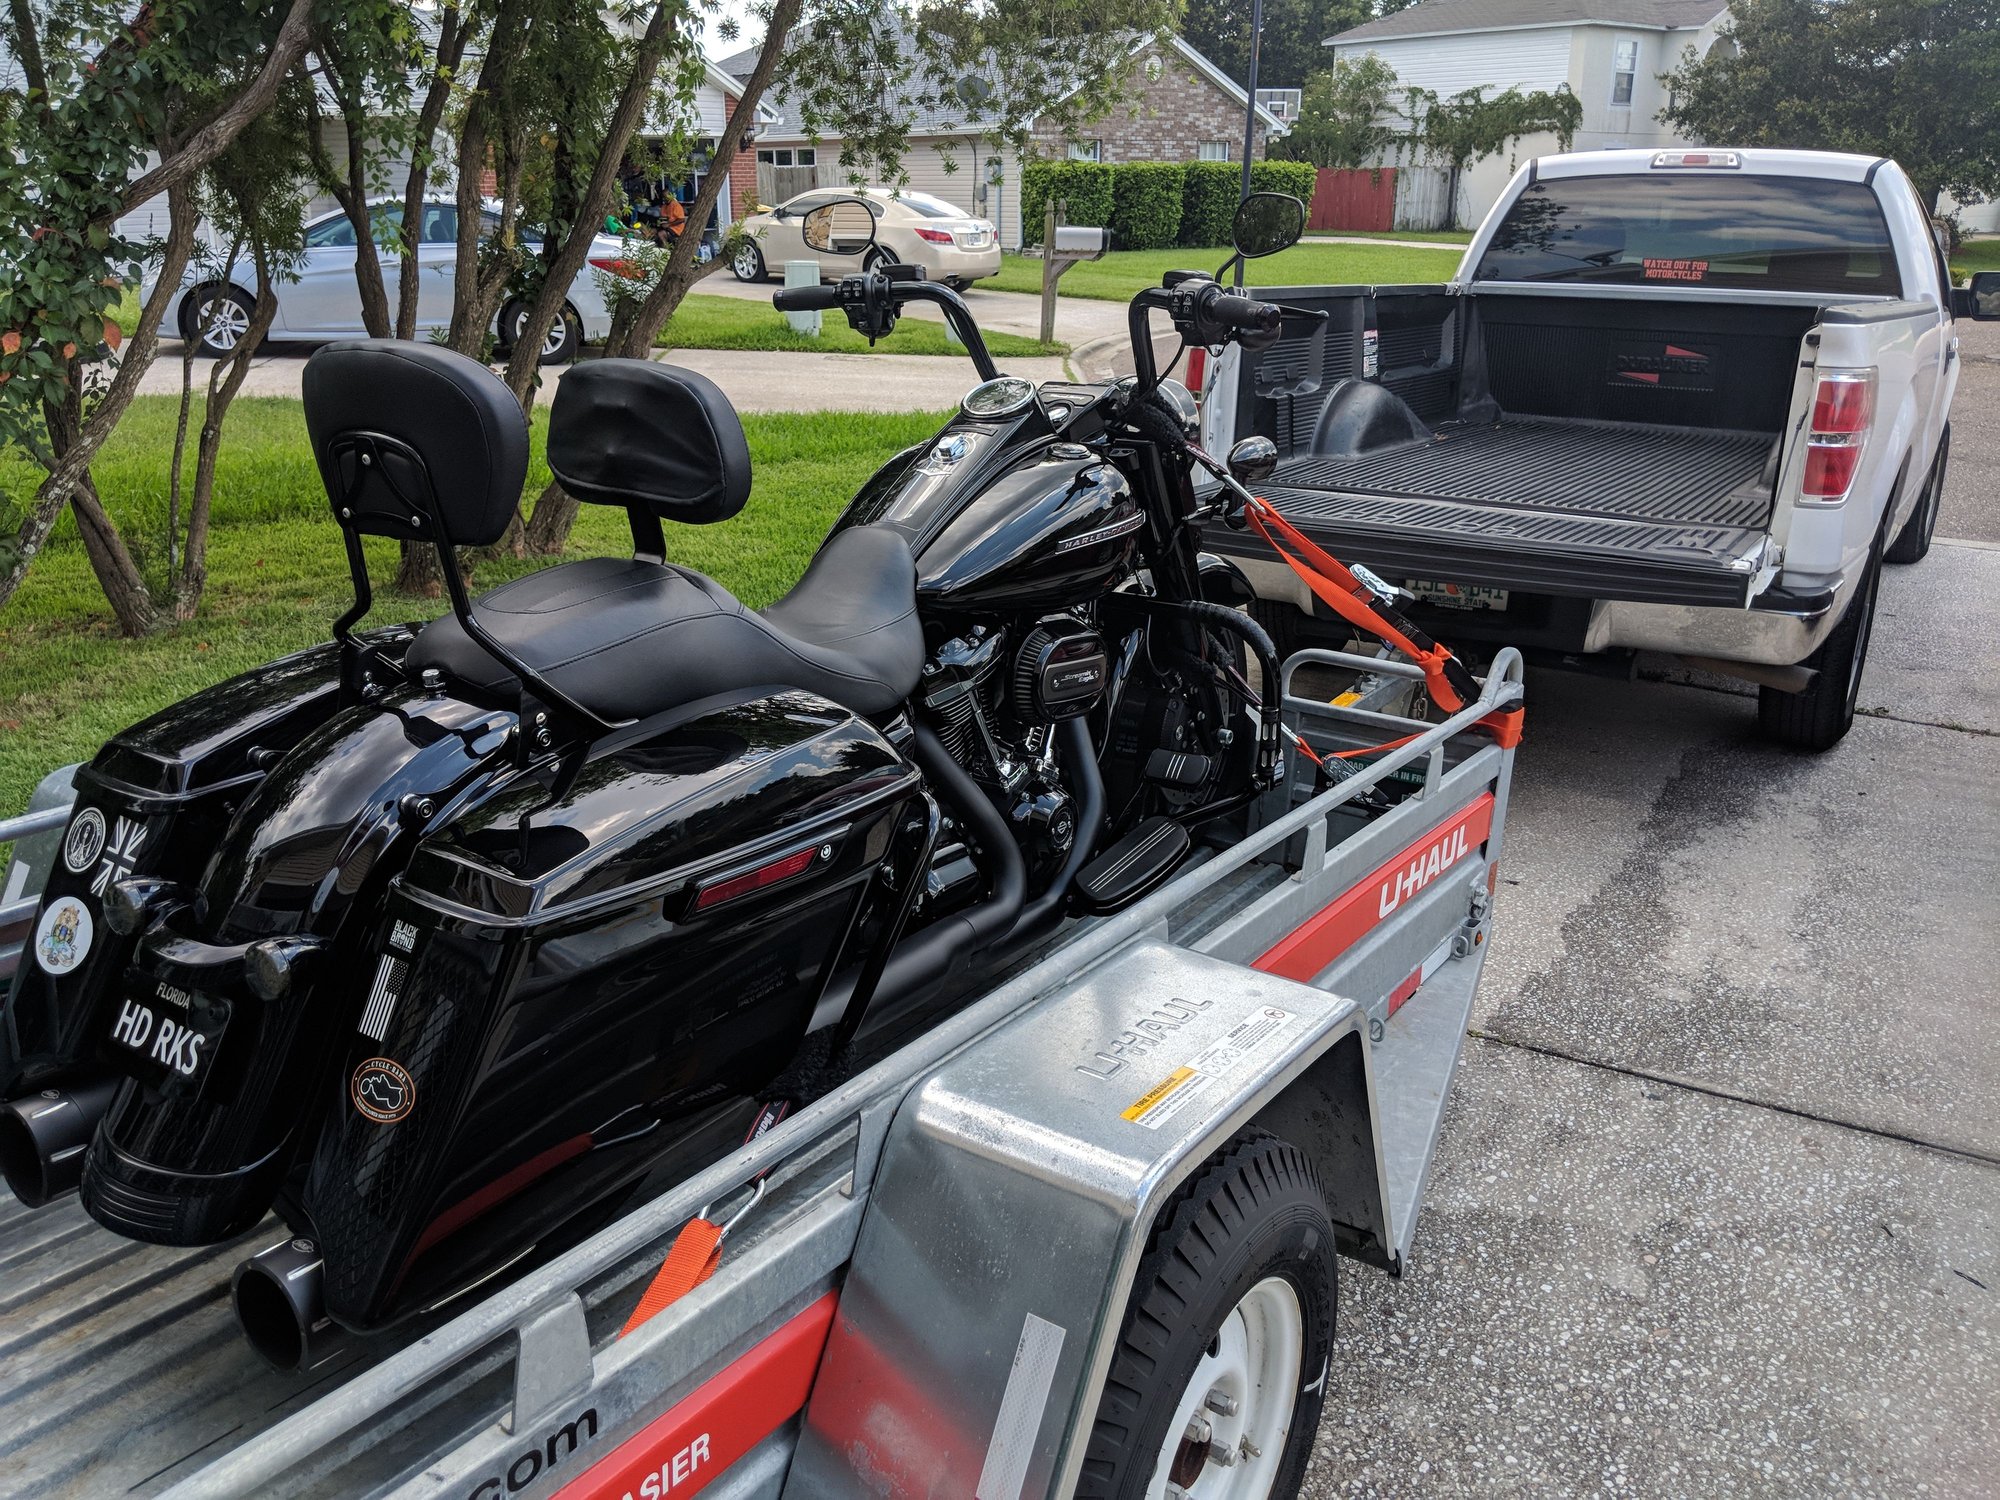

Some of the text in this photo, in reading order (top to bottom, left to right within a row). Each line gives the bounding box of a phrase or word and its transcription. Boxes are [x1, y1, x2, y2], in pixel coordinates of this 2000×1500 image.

[1643, 259, 1709, 271] WATCH OUT FOR
[1645, 269, 1703, 280] MOTORCYCLES
[394, 919, 419, 939] BLACK
[155, 982, 191, 1010] FLORIDA
[113, 999, 206, 1075] HD RKS
[1133, 1097, 1150, 1109] TIRE
[1147, 1076, 1178, 1099] PRESSURE
